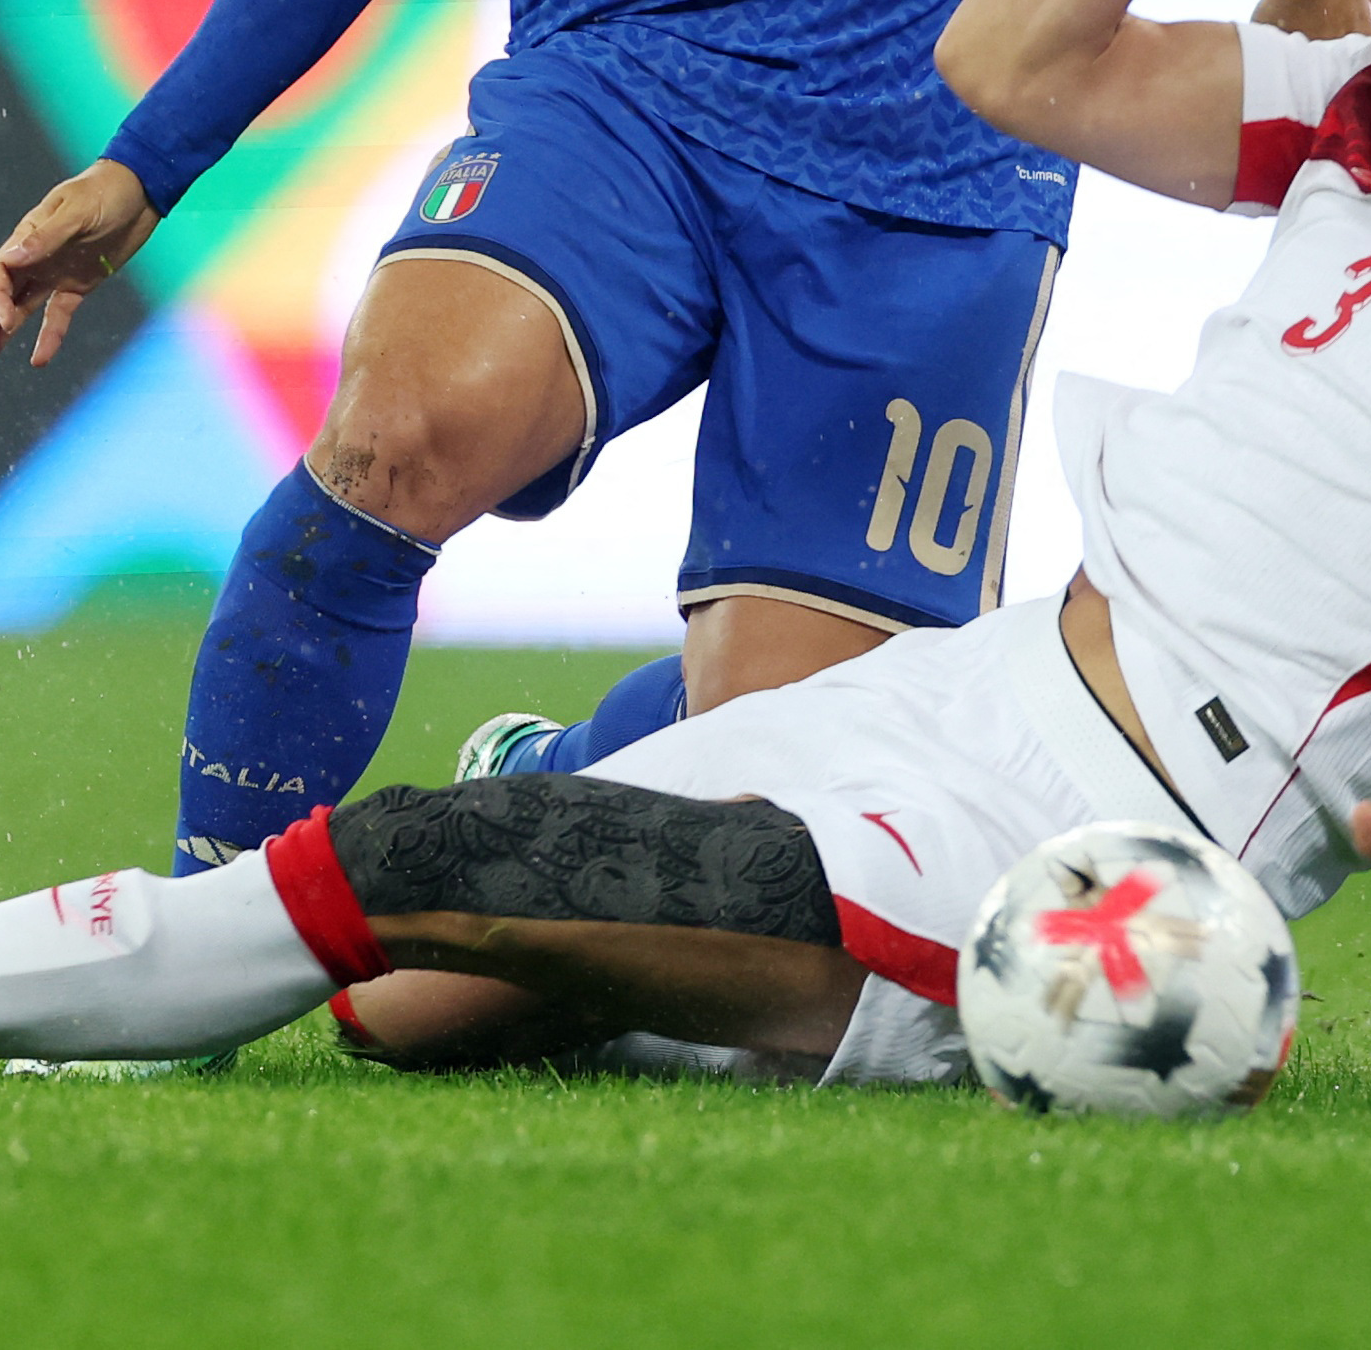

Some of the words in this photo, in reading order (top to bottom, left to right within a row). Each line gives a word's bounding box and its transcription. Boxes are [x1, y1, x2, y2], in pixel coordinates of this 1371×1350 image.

[442, 165, 487, 182] ITALIA
[865, 397, 993, 577] 10
[181, 735, 305, 795] ITALIA
